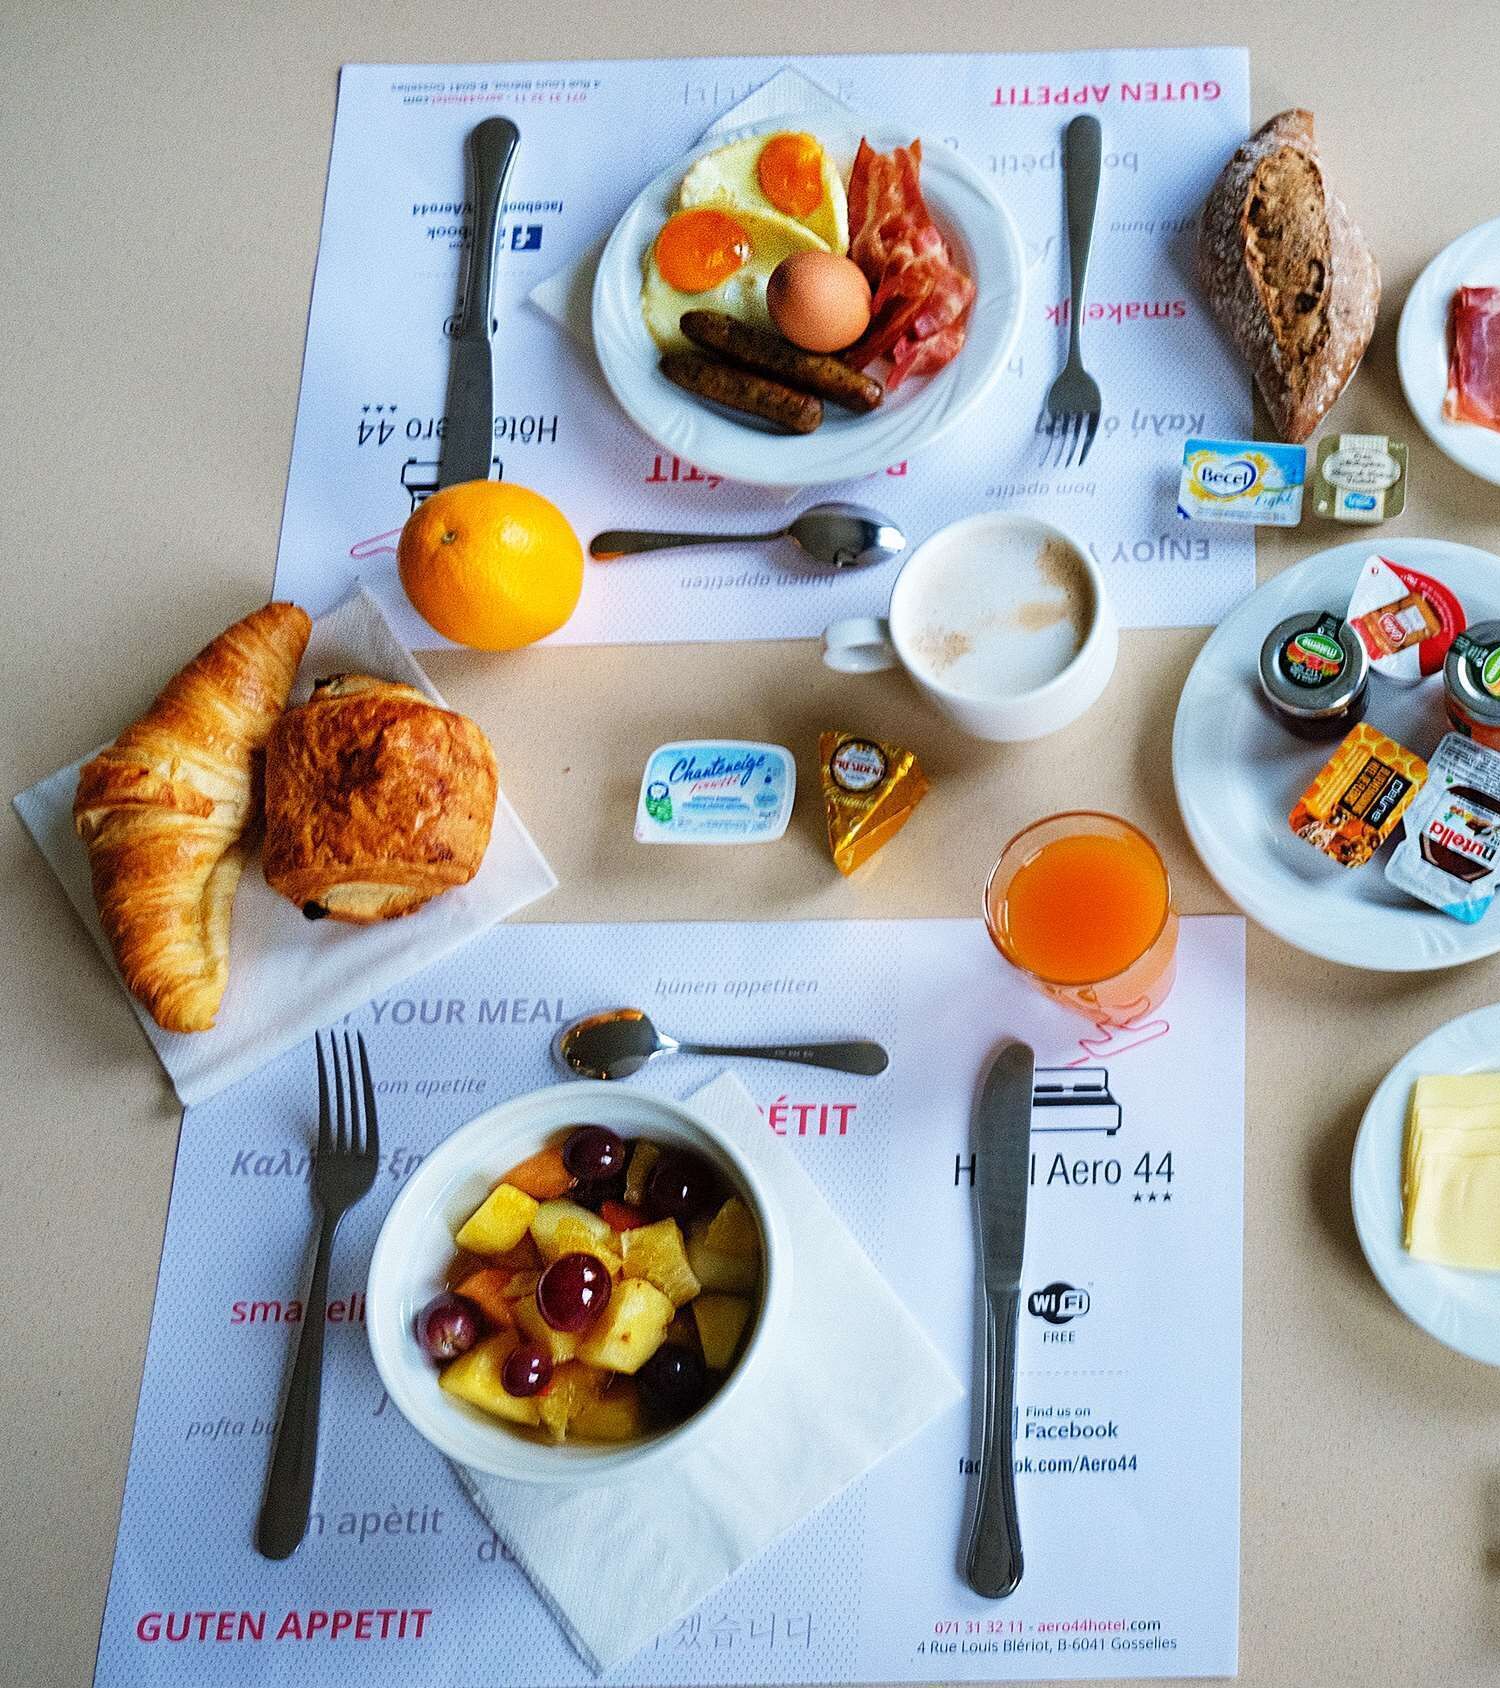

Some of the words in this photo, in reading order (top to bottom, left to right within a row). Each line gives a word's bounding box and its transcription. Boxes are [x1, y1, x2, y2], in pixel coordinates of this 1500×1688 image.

[990, 84, 1112, 107] APPETIT
[1120, 81, 1222, 103] GUTEN
[355, 418, 396, 445] 44
[404, 419, 438, 441] ero
[491, 416, 558, 447] Hôte
[1201, 466, 1251, 486] Becel
[1111, 535, 1211, 563] ENJOY
[1428, 819, 1497, 863] nutella
[368, 998, 467, 1026] YOUR
[477, 998, 572, 1025] MEAL
[1046, 1152, 1122, 1187] Aero
[1132, 1150, 1176, 1184] 44
[1042, 1330, 1077, 1344] FREE
[1025, 1405, 1054, 1418] Find
[1056, 1407, 1072, 1418] us
[1074, 1406, 1092, 1417] on
[1024, 1419, 1120, 1440] Facebook
[135, 1609, 267, 1643] GUTEN
[275, 1607, 434, 1642] APPETIT
[934, 1621, 961, 1635] 071
[930, 1641, 957, 1654] Rue
[961, 1640, 998, 1654] Louis
[1110, 1636, 1178, 1651] Gosselies
